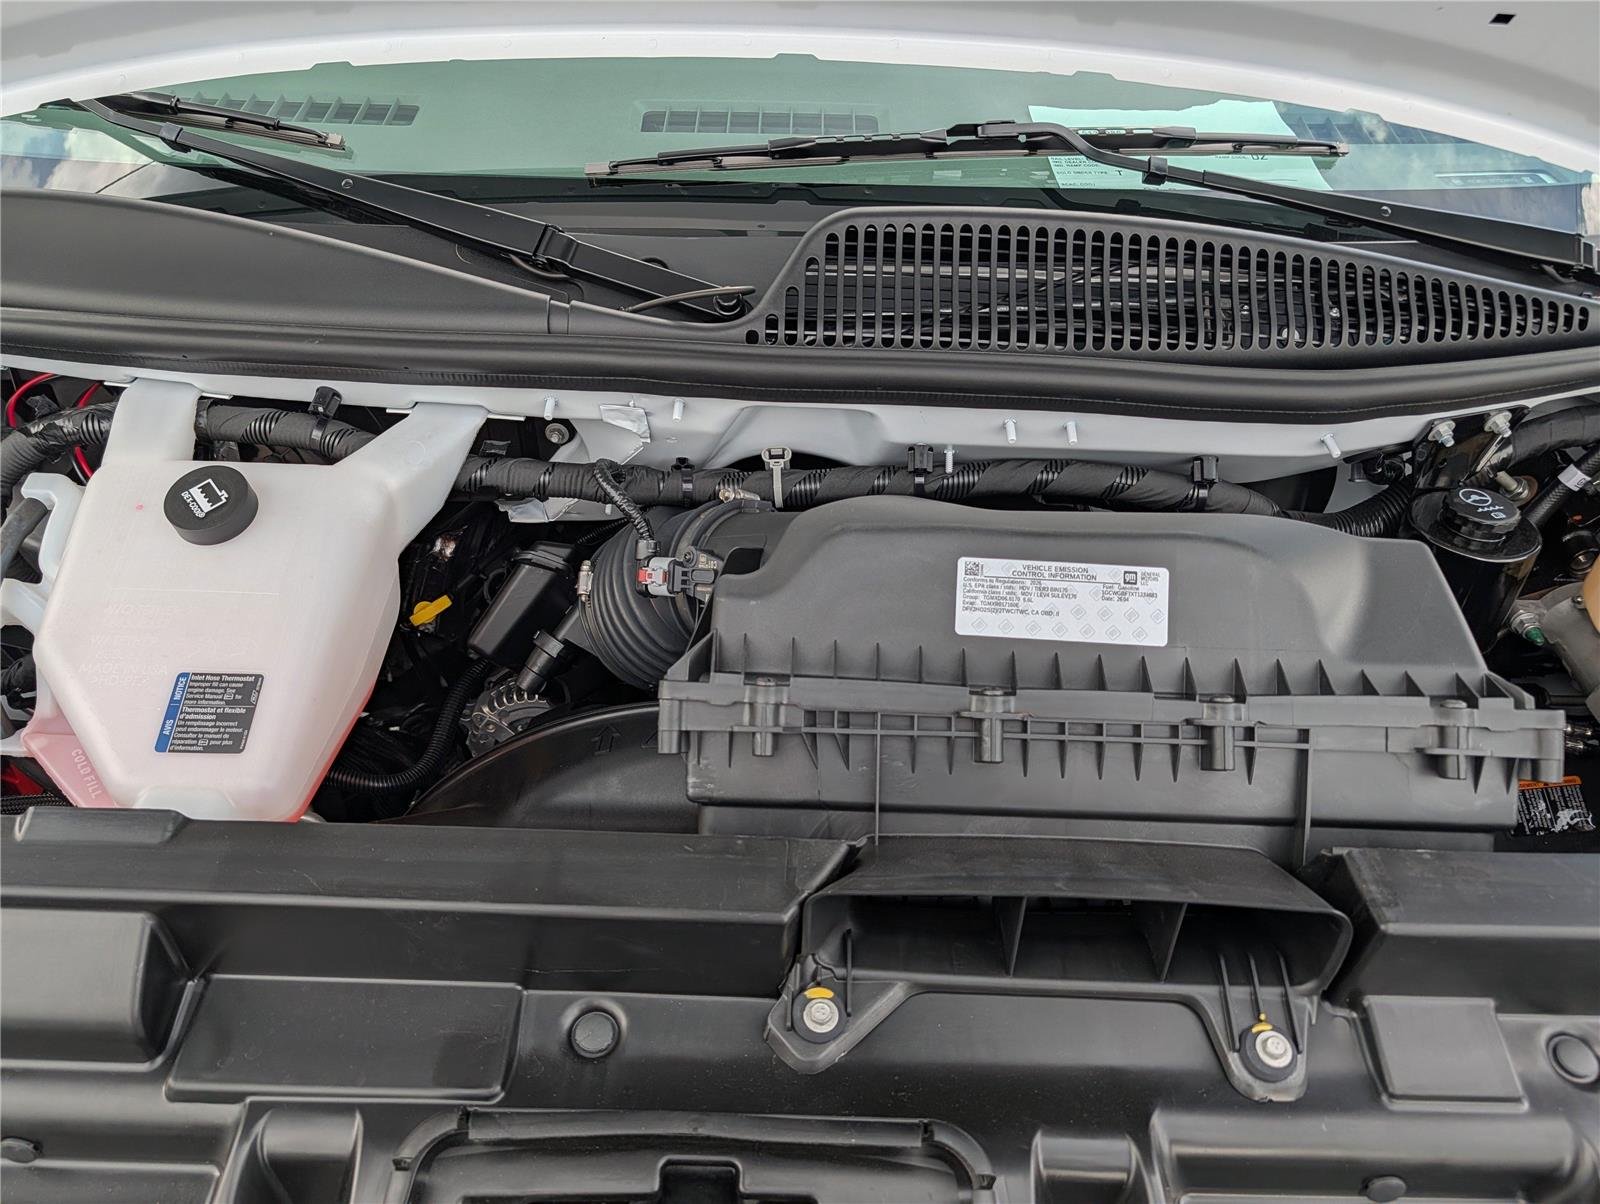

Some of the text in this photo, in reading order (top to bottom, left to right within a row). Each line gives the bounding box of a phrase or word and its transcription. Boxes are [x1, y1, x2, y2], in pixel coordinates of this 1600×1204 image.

[1012, 570, 1097, 581] CONTROL INFORMATION
[1124, 572, 1136, 584] gm
[173, 676, 187, 700] NOTICE
[163, 719, 174, 735] AVIS
[72, 748, 103, 799] COLD FILL
